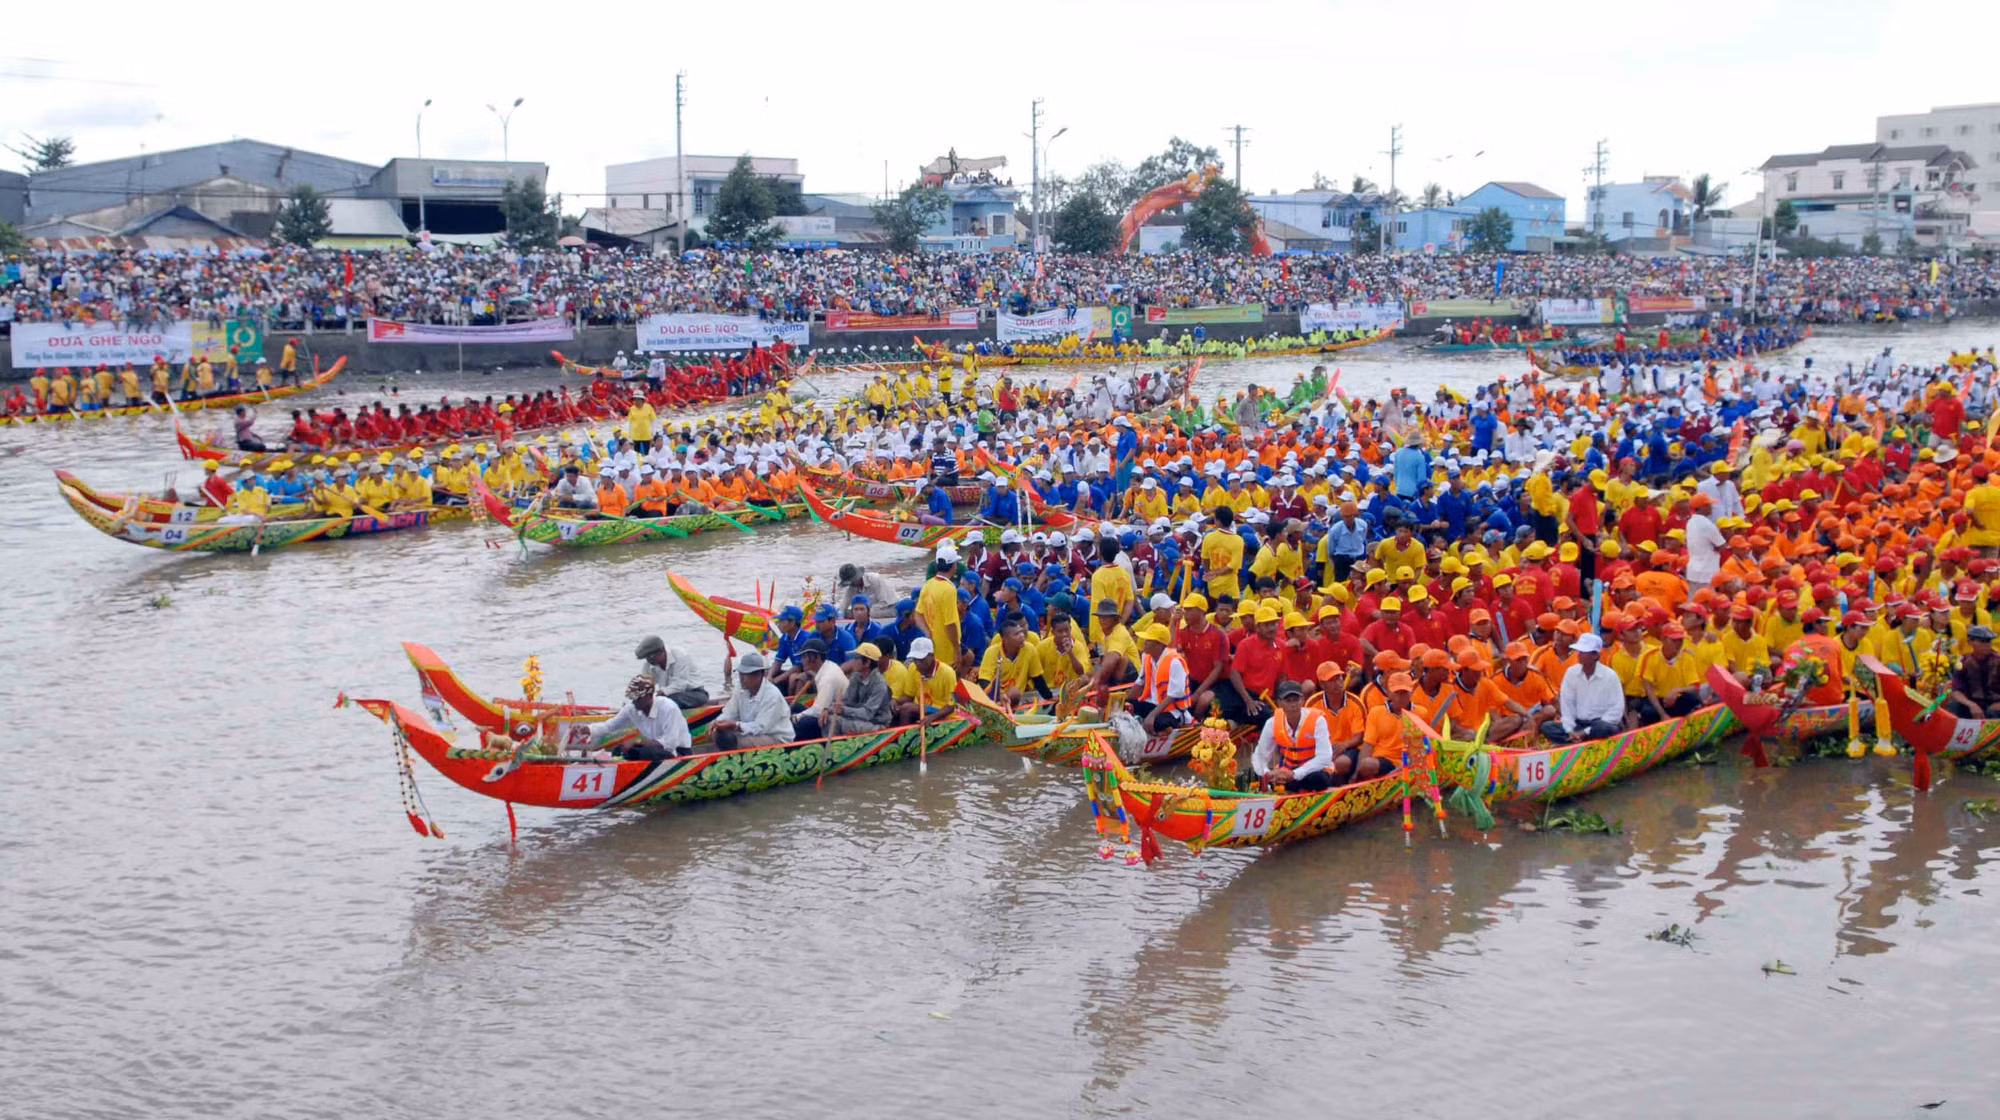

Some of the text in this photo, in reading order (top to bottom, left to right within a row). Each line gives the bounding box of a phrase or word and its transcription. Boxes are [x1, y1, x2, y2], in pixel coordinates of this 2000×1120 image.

[688, 324, 711, 334] GHE
[715, 322, 739, 333] NGO
[763, 323, 805, 336] syngenta
[89, 335, 122, 347] GHE
[128, 334, 162, 346] NGO
[870, 487, 884, 495] 06
[178, 512, 192, 521] 12
[165, 529, 182, 539] 04
[901, 528, 919, 538] 07
[1956, 728, 1974, 744] 42
[1144, 737, 1168, 754] 07
[1527, 761, 1544, 783] 16
[572, 773, 602, 792] 41
[1244, 808, 1265, 829] 18
